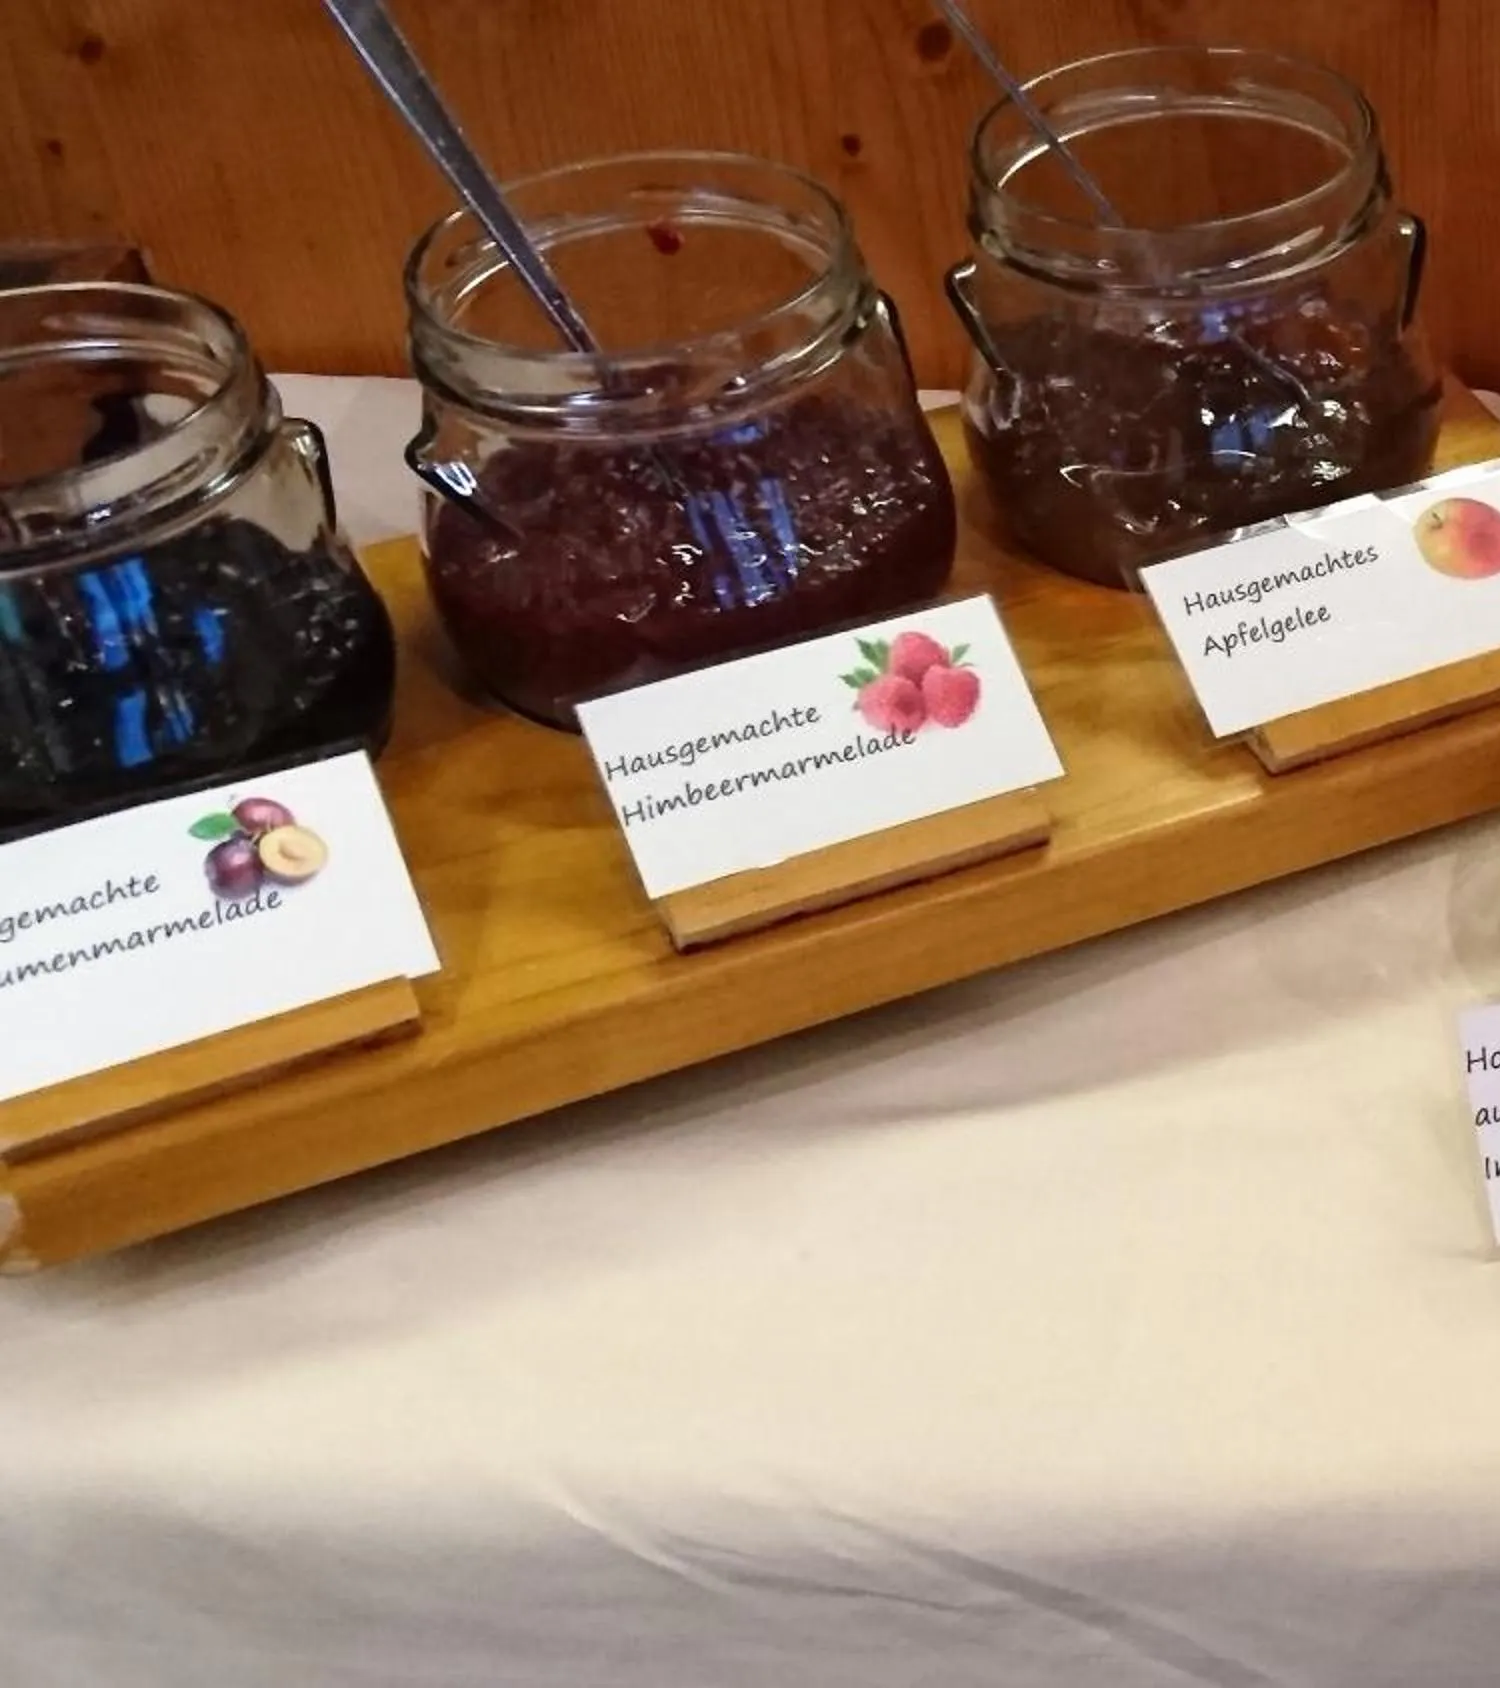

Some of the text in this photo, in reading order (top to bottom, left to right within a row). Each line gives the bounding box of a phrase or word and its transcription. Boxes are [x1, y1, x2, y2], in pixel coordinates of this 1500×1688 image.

[1183, 543, 1379, 616] Hausgemachtes
[1203, 604, 1331, 657] Apfelgelee
[604, 703, 820, 780] Hausgemachte
[621, 723, 916, 827] Himbeermarmelade
[0, 872, 161, 943] gemachte
